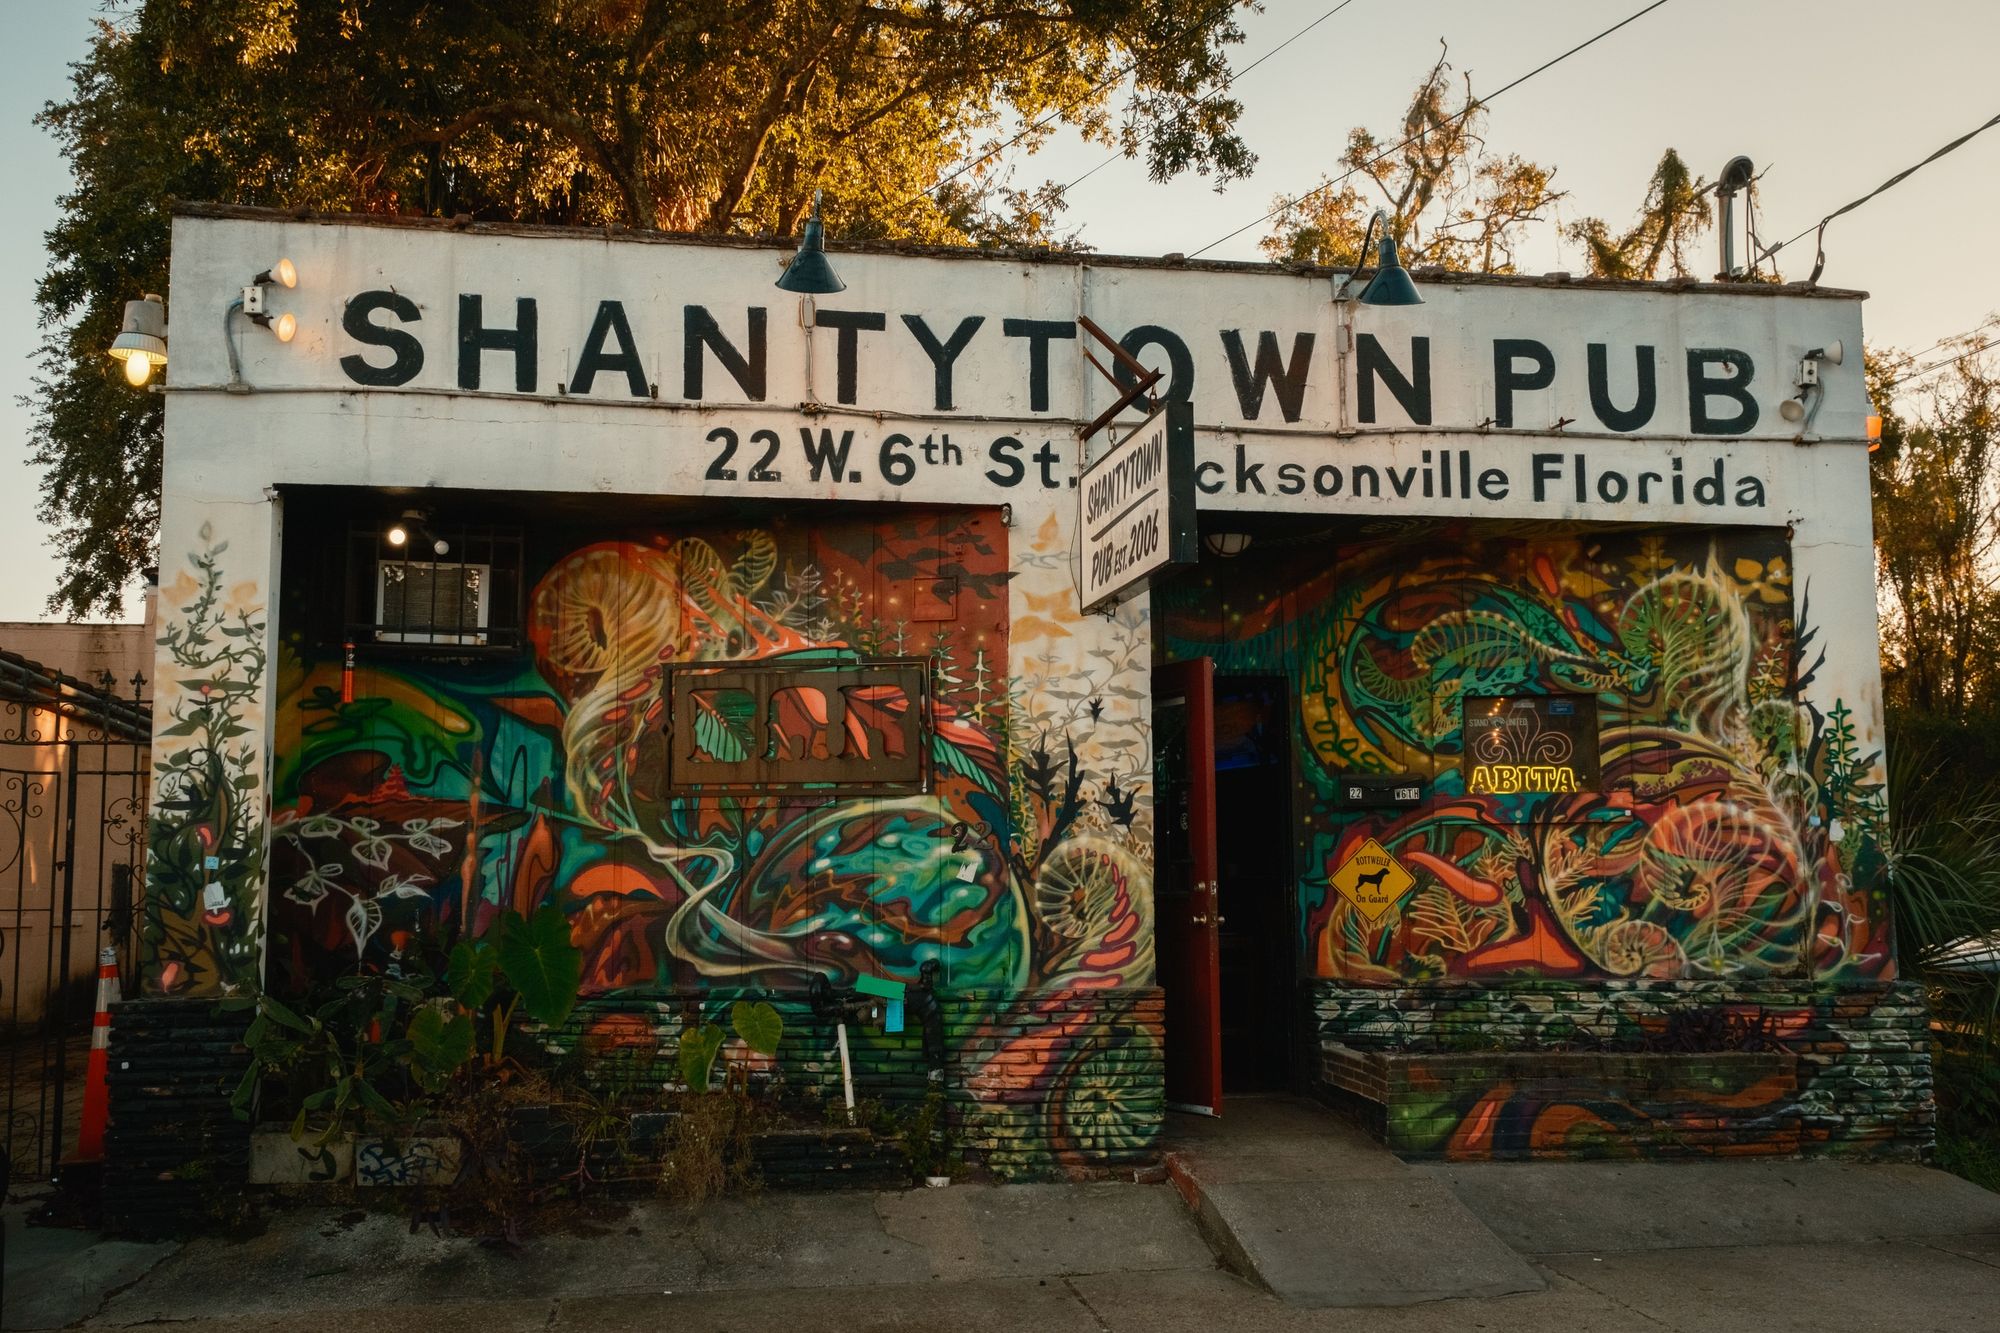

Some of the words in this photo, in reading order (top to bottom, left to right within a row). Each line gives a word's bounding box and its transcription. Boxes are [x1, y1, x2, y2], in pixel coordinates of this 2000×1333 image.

[340, 289, 1431, 426] SHANTYTOWN
[1493, 338, 1761, 435] PUB
[704, 427, 781, 482] 22
[879, 432, 963, 487] 6th
[1195, 444, 1510, 501] cksonville
[1532, 453, 1767, 508] Florida
[1086, 429, 1163, 525] SHANTYTOWN
[1091, 541, 1114, 592] PUB
[1114, 544, 1128, 576] EST.
[1128, 508, 1159, 569] 2006
[1350, 788, 1362, 799] 22
[1469, 765, 1577, 794] ABITA
[951, 820, 993, 854] 22
[1355, 855, 1391, 868] ROTTWEILER
[1356, 895, 1366, 904] On
[1368, 894, 1389, 904] Guard
